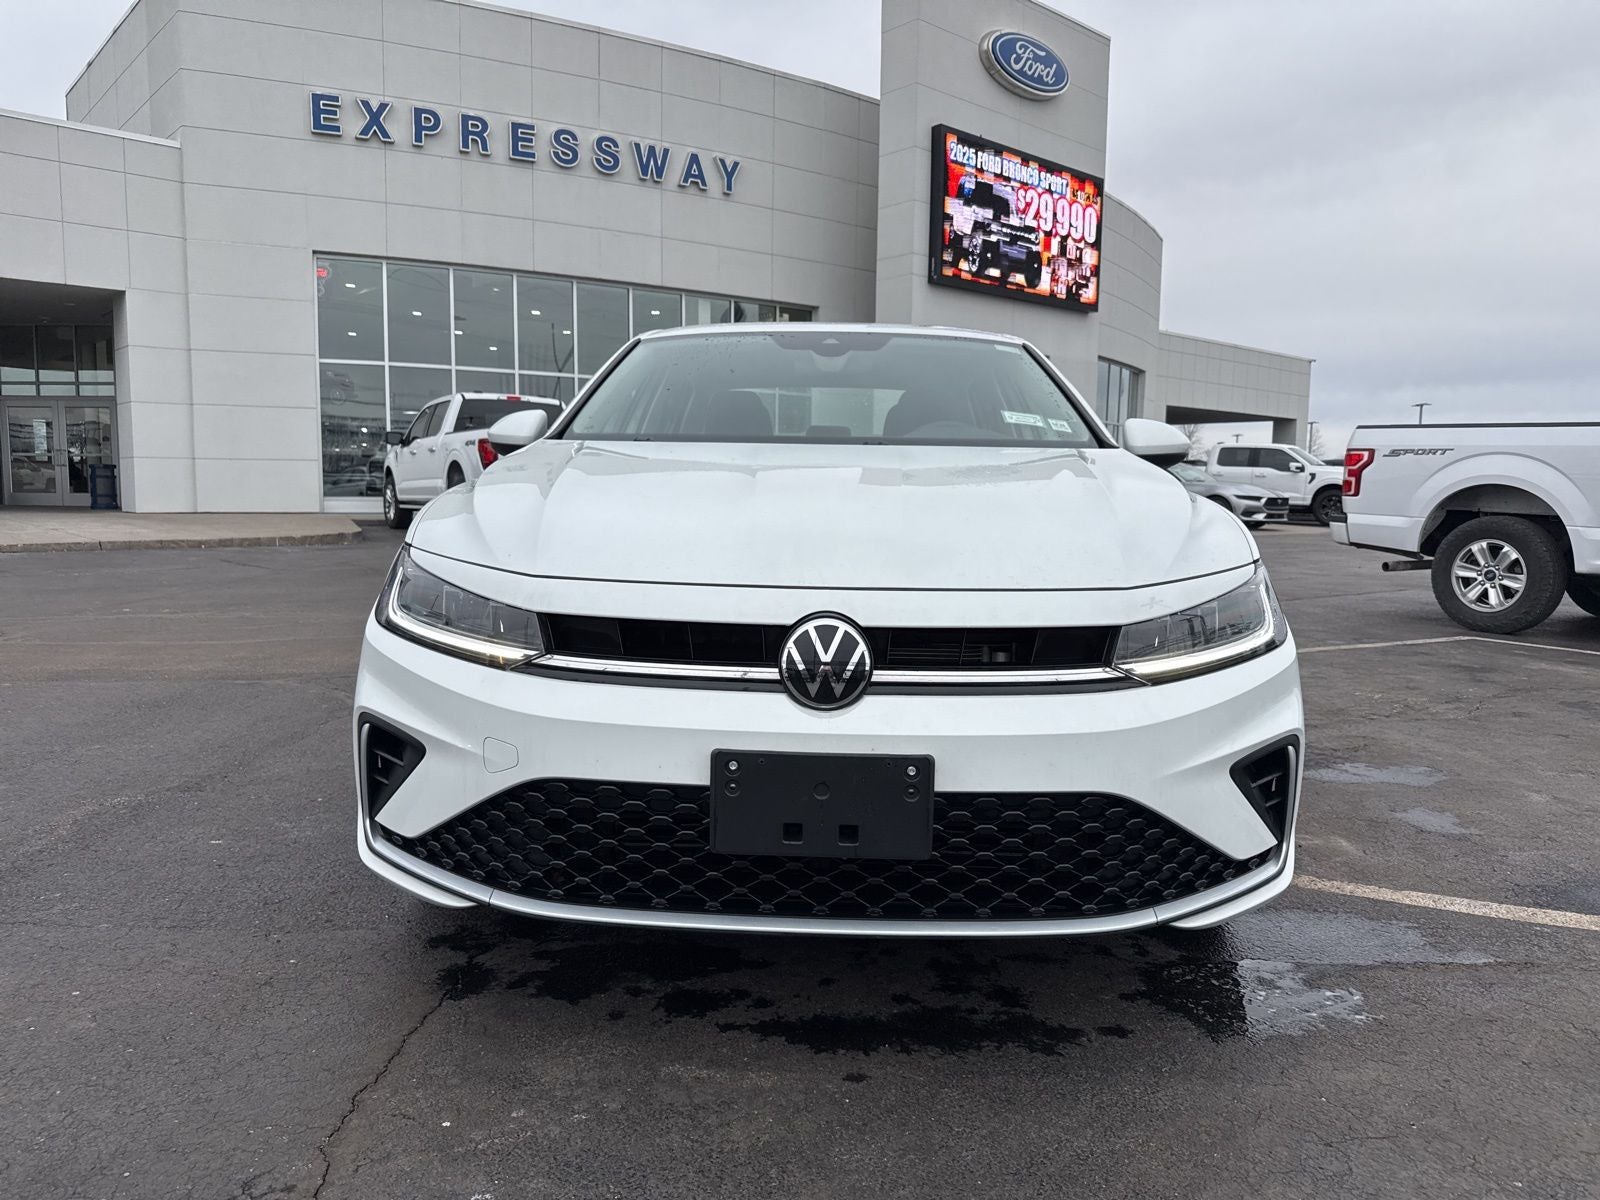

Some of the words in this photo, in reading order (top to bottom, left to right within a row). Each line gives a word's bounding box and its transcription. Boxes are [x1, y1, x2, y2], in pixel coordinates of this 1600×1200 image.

[1010, 41, 1057, 84] Ford
[309, 91, 741, 194] EXPRESSWAY
[949, 141, 976, 168] 2025
[976, 150, 1002, 174] FORD
[1002, 158, 1040, 186] BRONCO
[1040, 171, 1068, 195] SPORT
[1017, 187, 1097, 244] $29,990
[1382, 448, 1455, 458] SPORT
